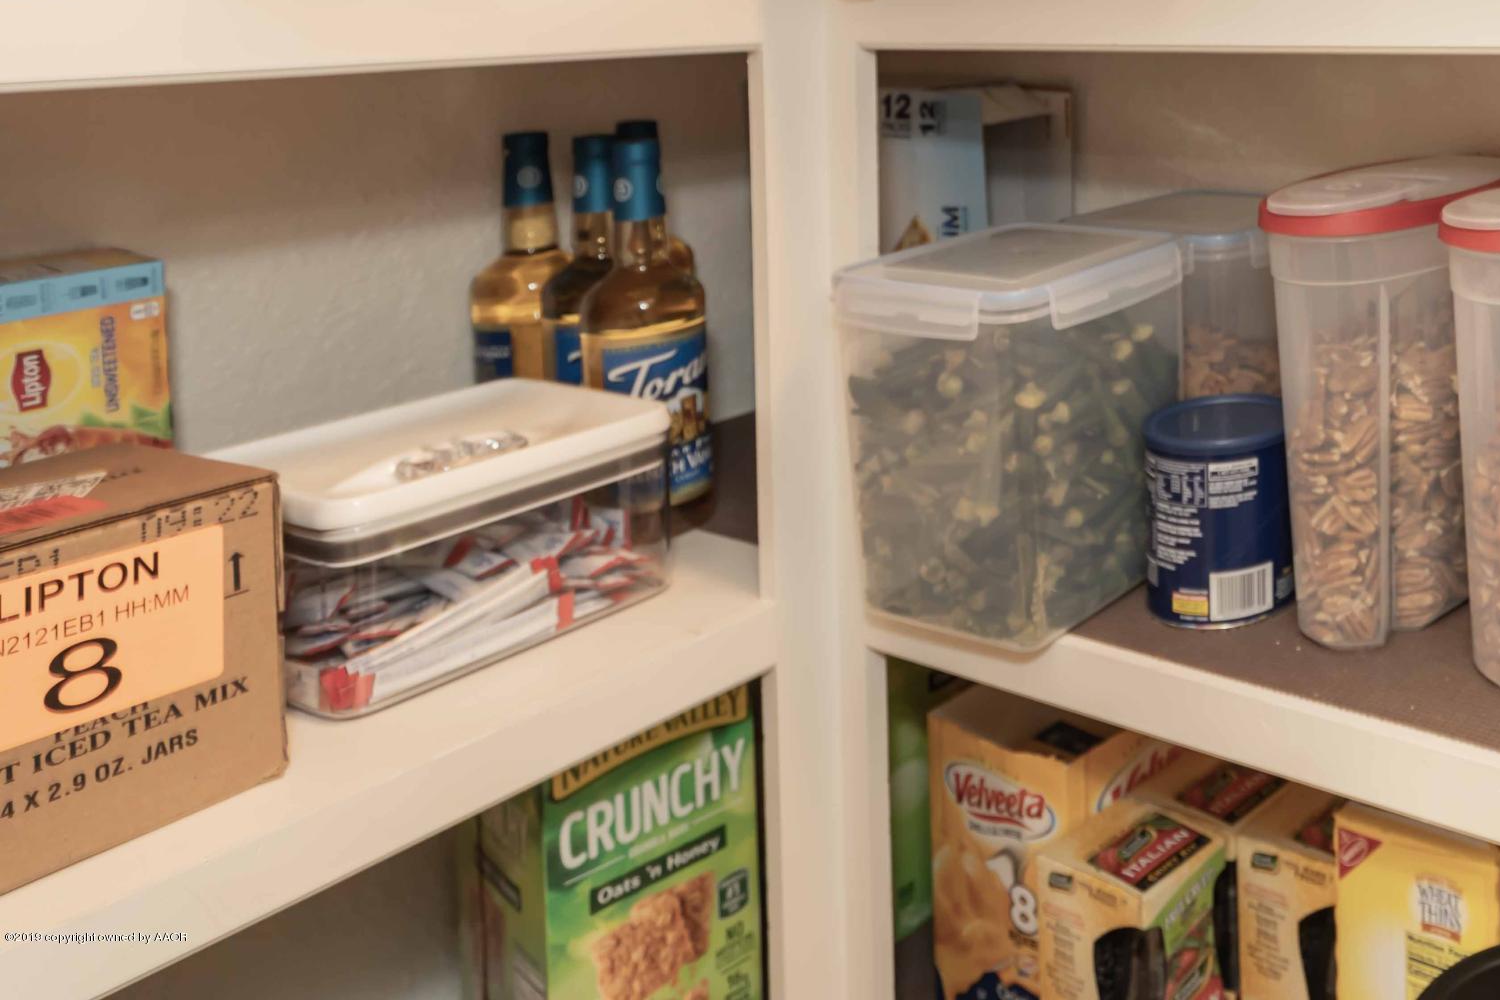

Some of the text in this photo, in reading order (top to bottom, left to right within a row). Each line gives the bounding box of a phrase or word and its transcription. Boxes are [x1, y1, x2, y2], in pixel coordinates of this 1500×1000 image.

[882, 94, 911, 119] 12
[21, 354, 47, 408] Lipton
[100, 316, 120, 414] UNSWEETENED
[0, 551, 159, 624] LIPTON
[115, 585, 189, 623] HH:MM
[43, 637, 122, 713] 8
[32, 730, 111, 774] ICED
[122, 704, 183, 738] TEA
[194, 677, 249, 712] MIX
[24, 790, 39, 812] X
[48, 772, 87, 803] 2.9
[95, 756, 133, 784] OZ.
[141, 728, 199, 765] JARS
[953, 770, 1046, 818] Velveeta
[559, 738, 746, 870] CRUNCHY
[597, 876, 641, 905] Oats
[666, 836, 722, 870] Honey
[1121, 828, 1191, 879] ITALIAN
[1010, 885, 1038, 936] 8
[1417, 884, 1463, 909] WHEAT
[1419, 900, 1462, 932] THINS
